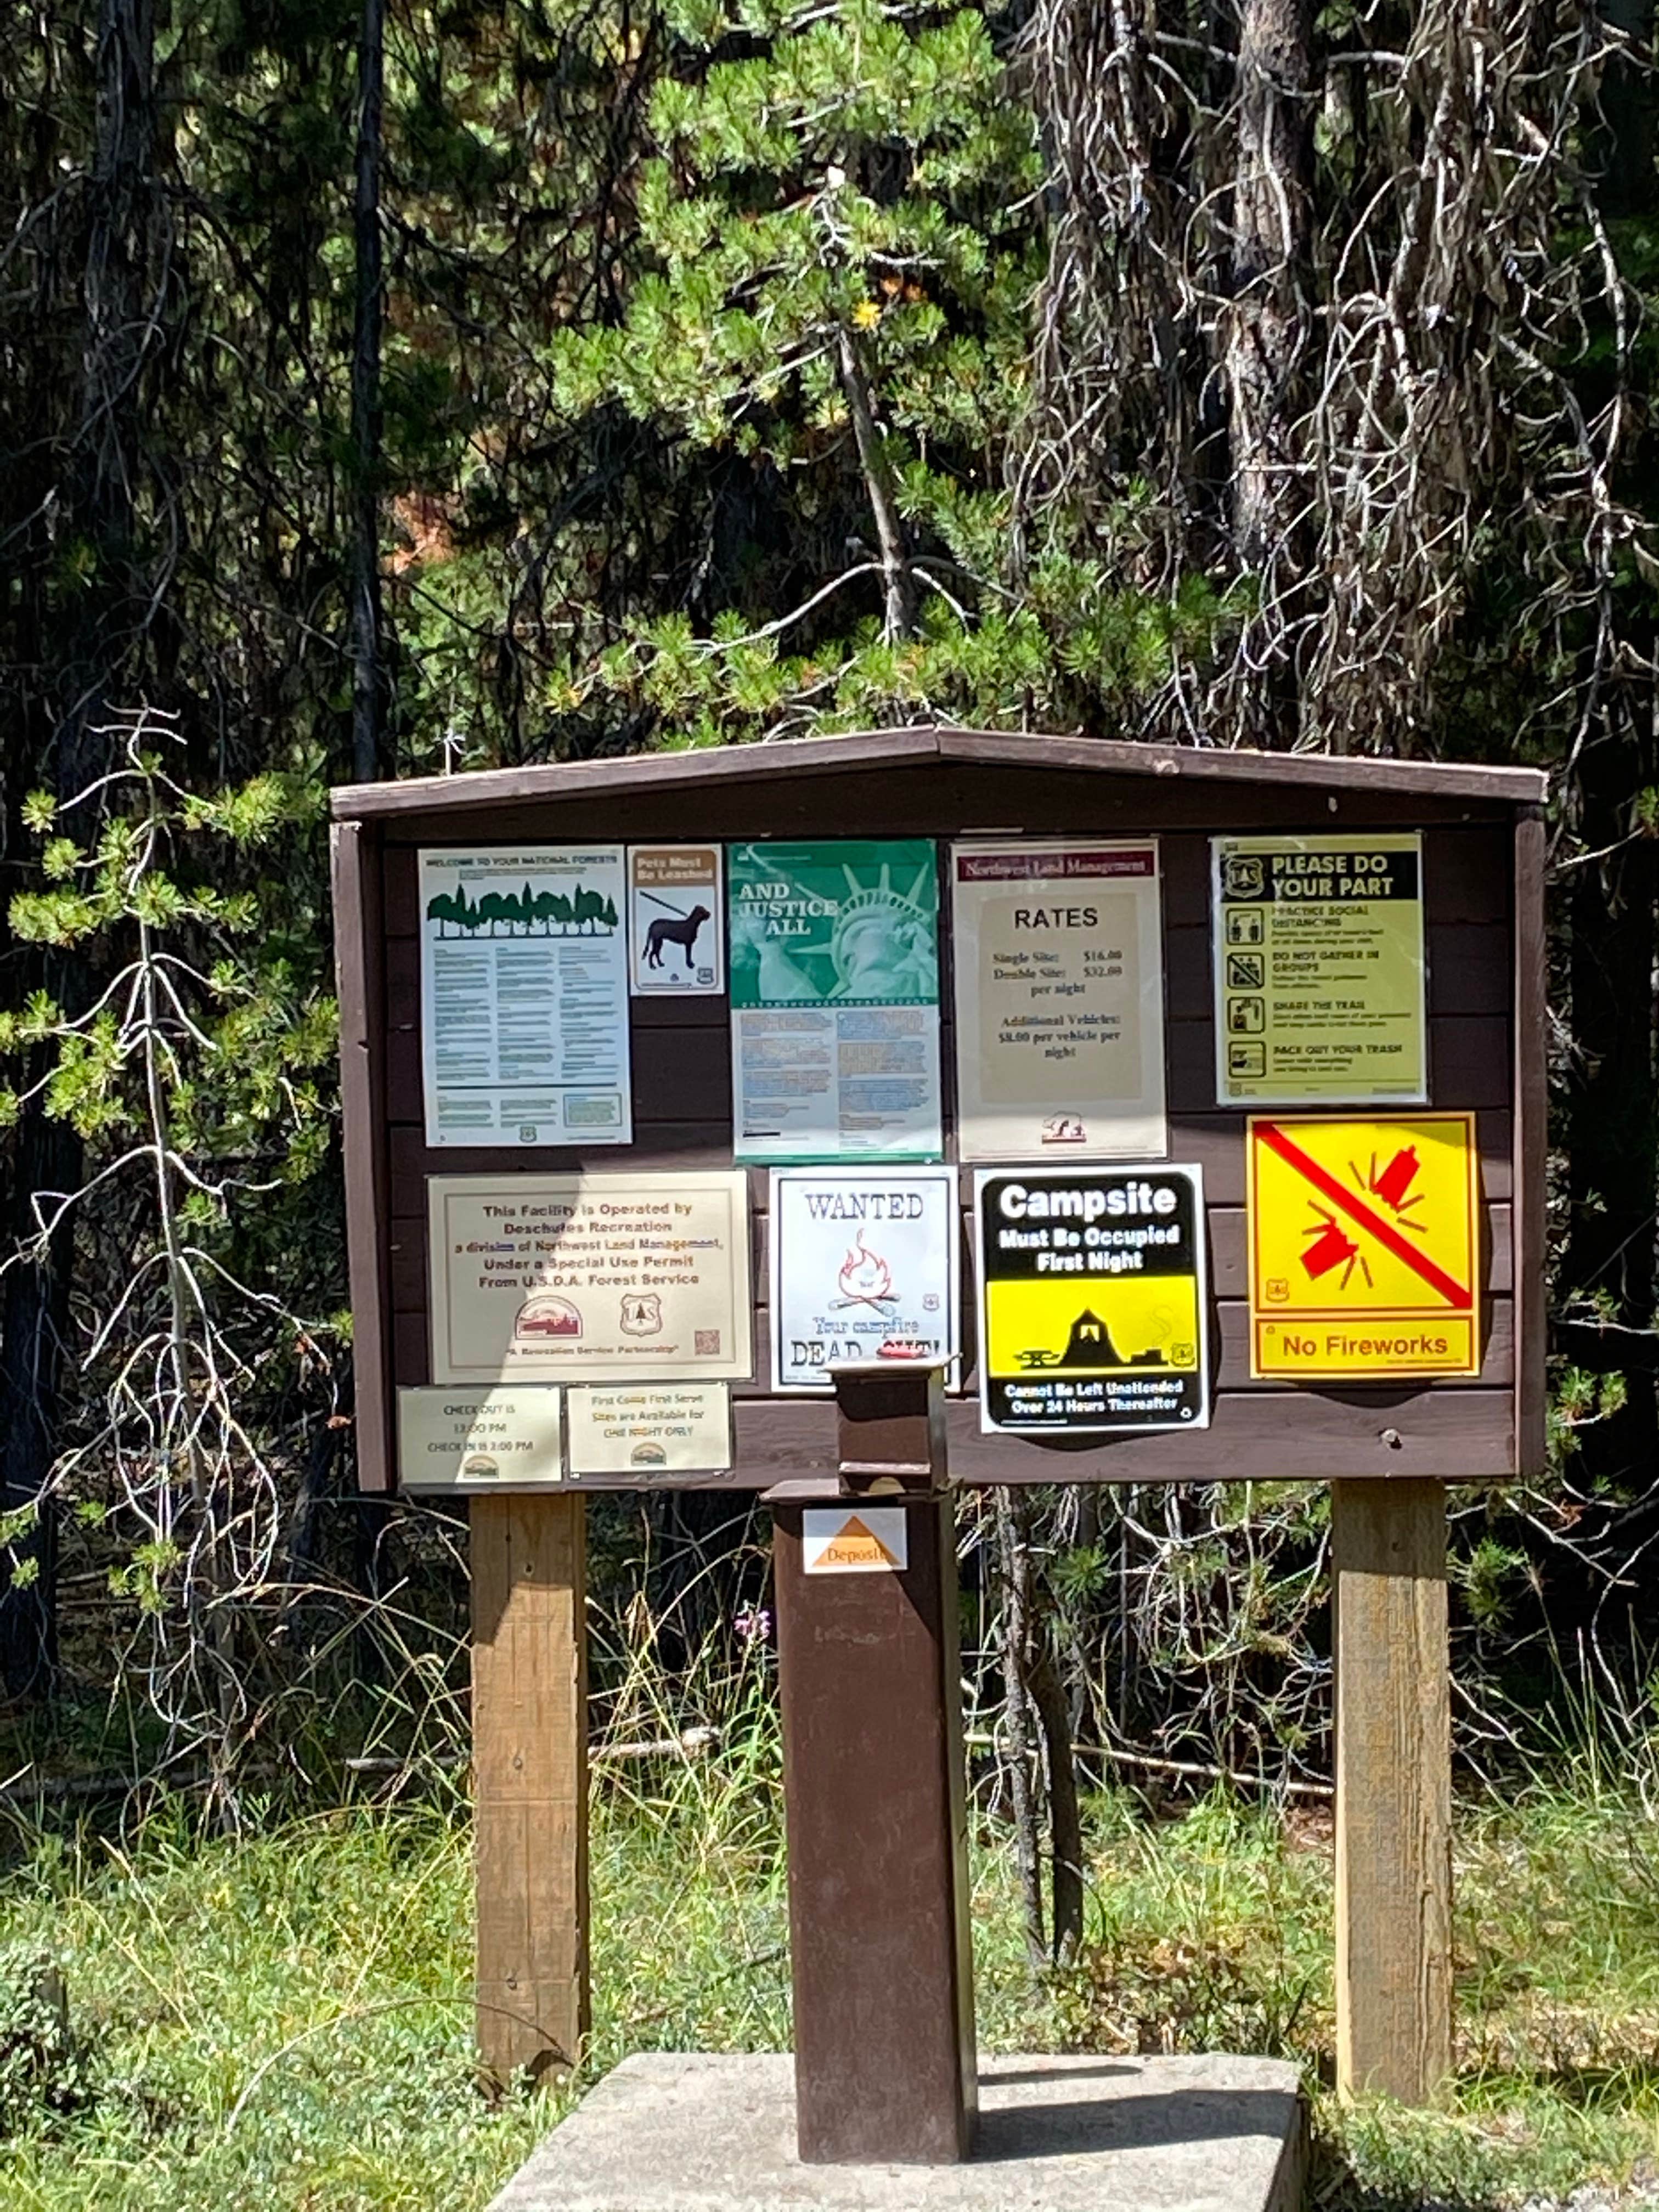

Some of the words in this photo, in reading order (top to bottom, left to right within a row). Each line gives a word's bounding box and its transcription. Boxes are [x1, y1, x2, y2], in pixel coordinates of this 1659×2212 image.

[637, 857, 667, 868] Pets
[669, 857, 701, 868] Must
[1067, 859, 1146, 874] Management
[1272, 856, 1347, 874] PLEASE
[1354, 855, 1388, 873] DO
[637, 870, 655, 880] Be
[658, 868, 713, 879] Leashed
[739, 883, 790, 900] AND
[1272, 879, 1333, 896] YOUR
[1339, 877, 1393, 896] PART
[738, 900, 839, 917] JUSTICE
[1014, 907, 1098, 929] RATES
[766, 919, 811, 935] ALL
[1273, 952, 1289, 961] DO
[1293, 951, 1316, 960] NOT
[1319, 950, 1363, 960] GATHER
[1031, 986, 1052, 998] per
[1054, 982, 1086, 996] night
[1312, 1001, 1332, 1010] THE
[1033, 1034, 1053, 1045] per
[1056, 1030, 1097, 1042] vehicle
[1100, 1031, 1121, 1043] per
[1045, 1047, 1076, 1059] night
[1365, 1044, 1402, 1053] TRASH
[805, 1193, 924, 1220] WANTED
[1000, 1181, 1177, 1222] Campsite
[483, 1206, 516, 1217] This
[521, 1205, 575, 1218] Facility
[582, 1205, 594, 1216] is
[600, 1204, 669, 1217] Operated
[674, 1203, 692, 1216] by
[504, 1222, 584, 1234] Deschutes
[589, 1221, 673, 1233] Recreation
[998, 1229, 1049, 1248] Must
[1052, 1227, 1081, 1247] Be
[1084, 1224, 1180, 1248] Occupied
[466, 1242, 515, 1253] division
[518, 1240, 531, 1251] of
[535, 1239, 601, 1252] Northwest
[605, 1239, 636, 1250] Land
[484, 1259, 529, 1269] Under
[534, 1260, 543, 1269] a
[548, 1257, 604, 1271] Special
[610, 1257, 639, 1268] Use
[644, 1255, 694, 1268] Permit
[1037, 1251, 1084, 1272] First
[1088, 1250, 1144, 1273] Night
[479, 1277, 517, 1288] From
[588, 1273, 636, 1286] Forest
[641, 1273, 699, 1285] Service
[812, 1317, 848, 1335] Your
[853, 1316, 920, 1339] campfire
[1283, 1335, 1317, 1356] No
[1326, 1334, 1448, 1356] Fireworks
[791, 1340, 862, 1367] DEAD
[1005, 1384, 1053, 1397] Cannot
[1055, 1383, 1074, 1396] Be
[1076, 1381, 1103, 1396] Left
[1105, 1379, 1183, 1395] Unattended
[1011, 1400, 1044, 1413] Over
[1047, 1400, 1063, 1413] 24
[1066, 1399, 1105, 1413] Hours
[1107, 1397, 1178, 1412] Thereafter
[619, 1413, 635, 1421] are
[638, 1410, 686, 1420] Available
[488, 1423, 507, 1432] PM
[515, 1441, 534, 1451] PM
[827, 1547, 887, 1564] Deposit
